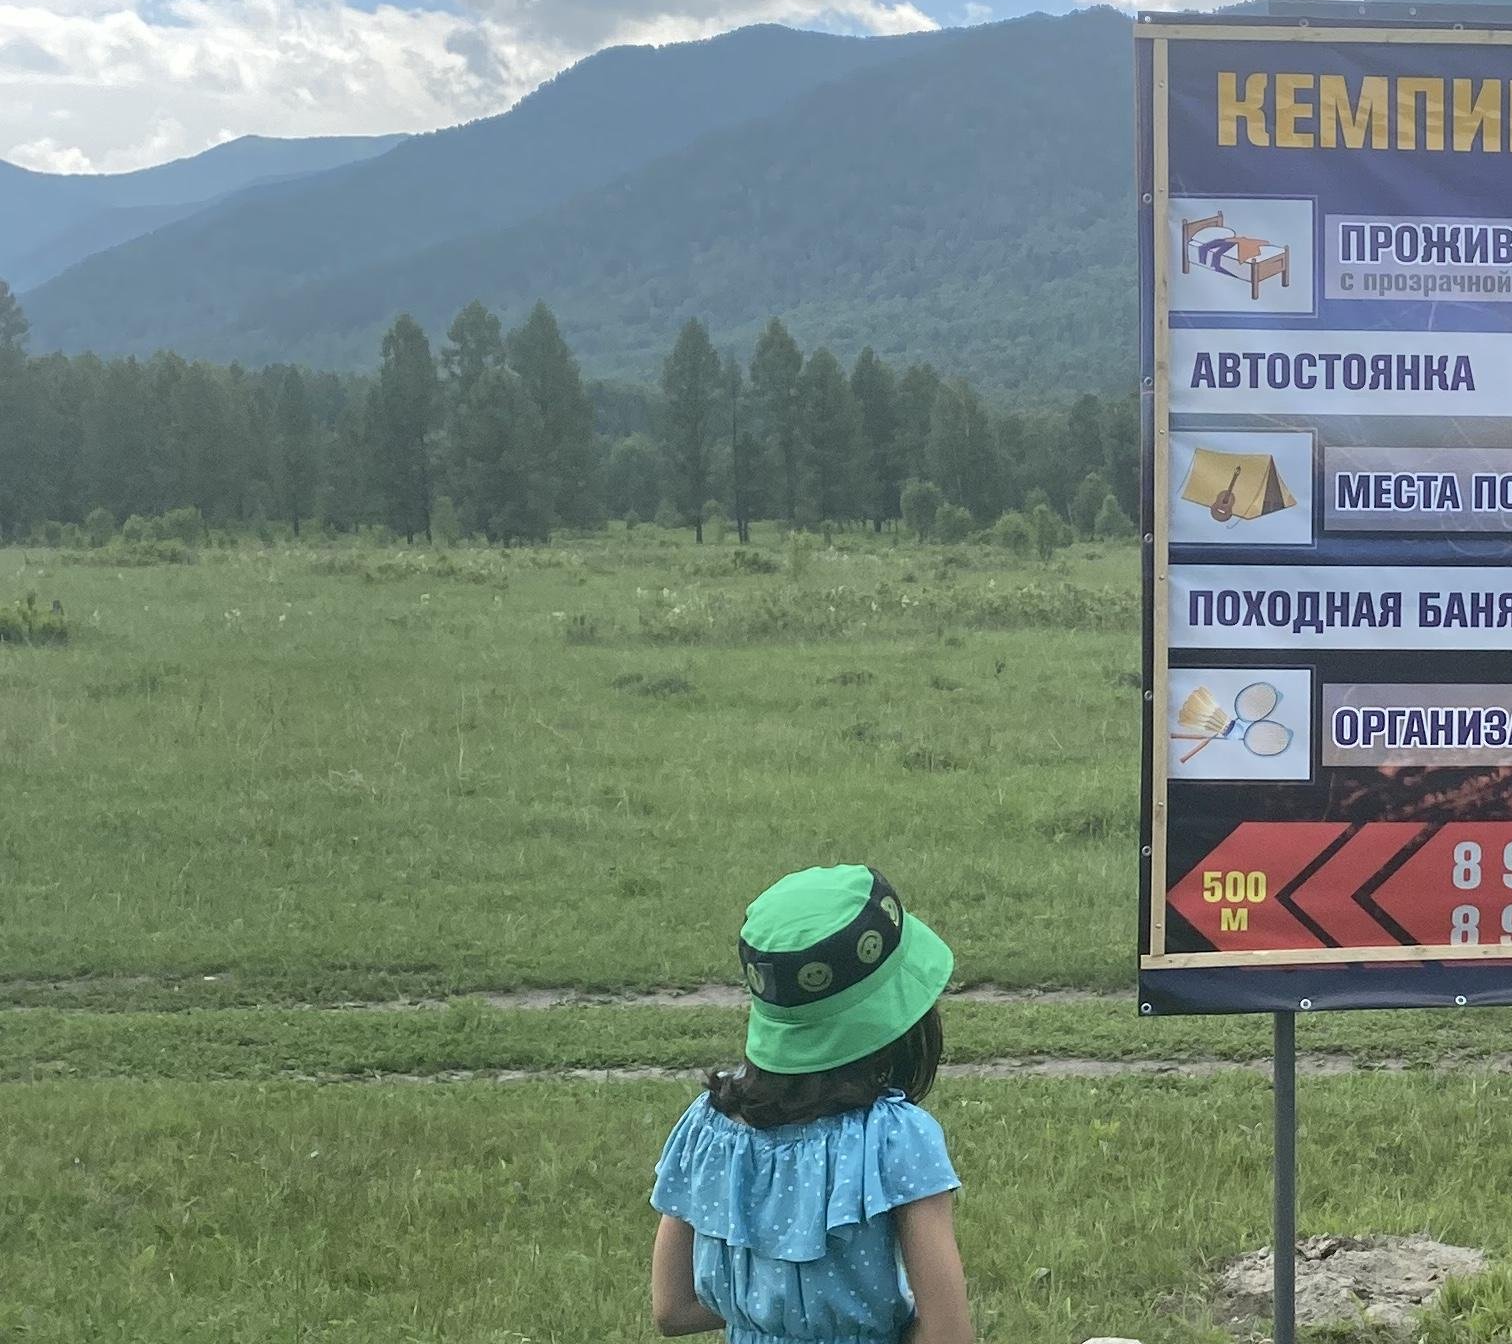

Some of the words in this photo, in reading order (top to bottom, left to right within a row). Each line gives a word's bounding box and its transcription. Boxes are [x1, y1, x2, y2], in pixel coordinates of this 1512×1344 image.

[1341, 273, 1353, 291] с
[1363, 270, 1512, 297] прозрачной
[1190, 352, 1475, 391] АВТОСТОЯНКА
[1336, 473, 1461, 511] МЕСТА
[1189, 590, 1401, 633] ПОХОДНАЯ
[1452, 840, 1482, 889] 8
[1203, 871, 1267, 903] 500
[1450, 905, 1480, 945] 8
